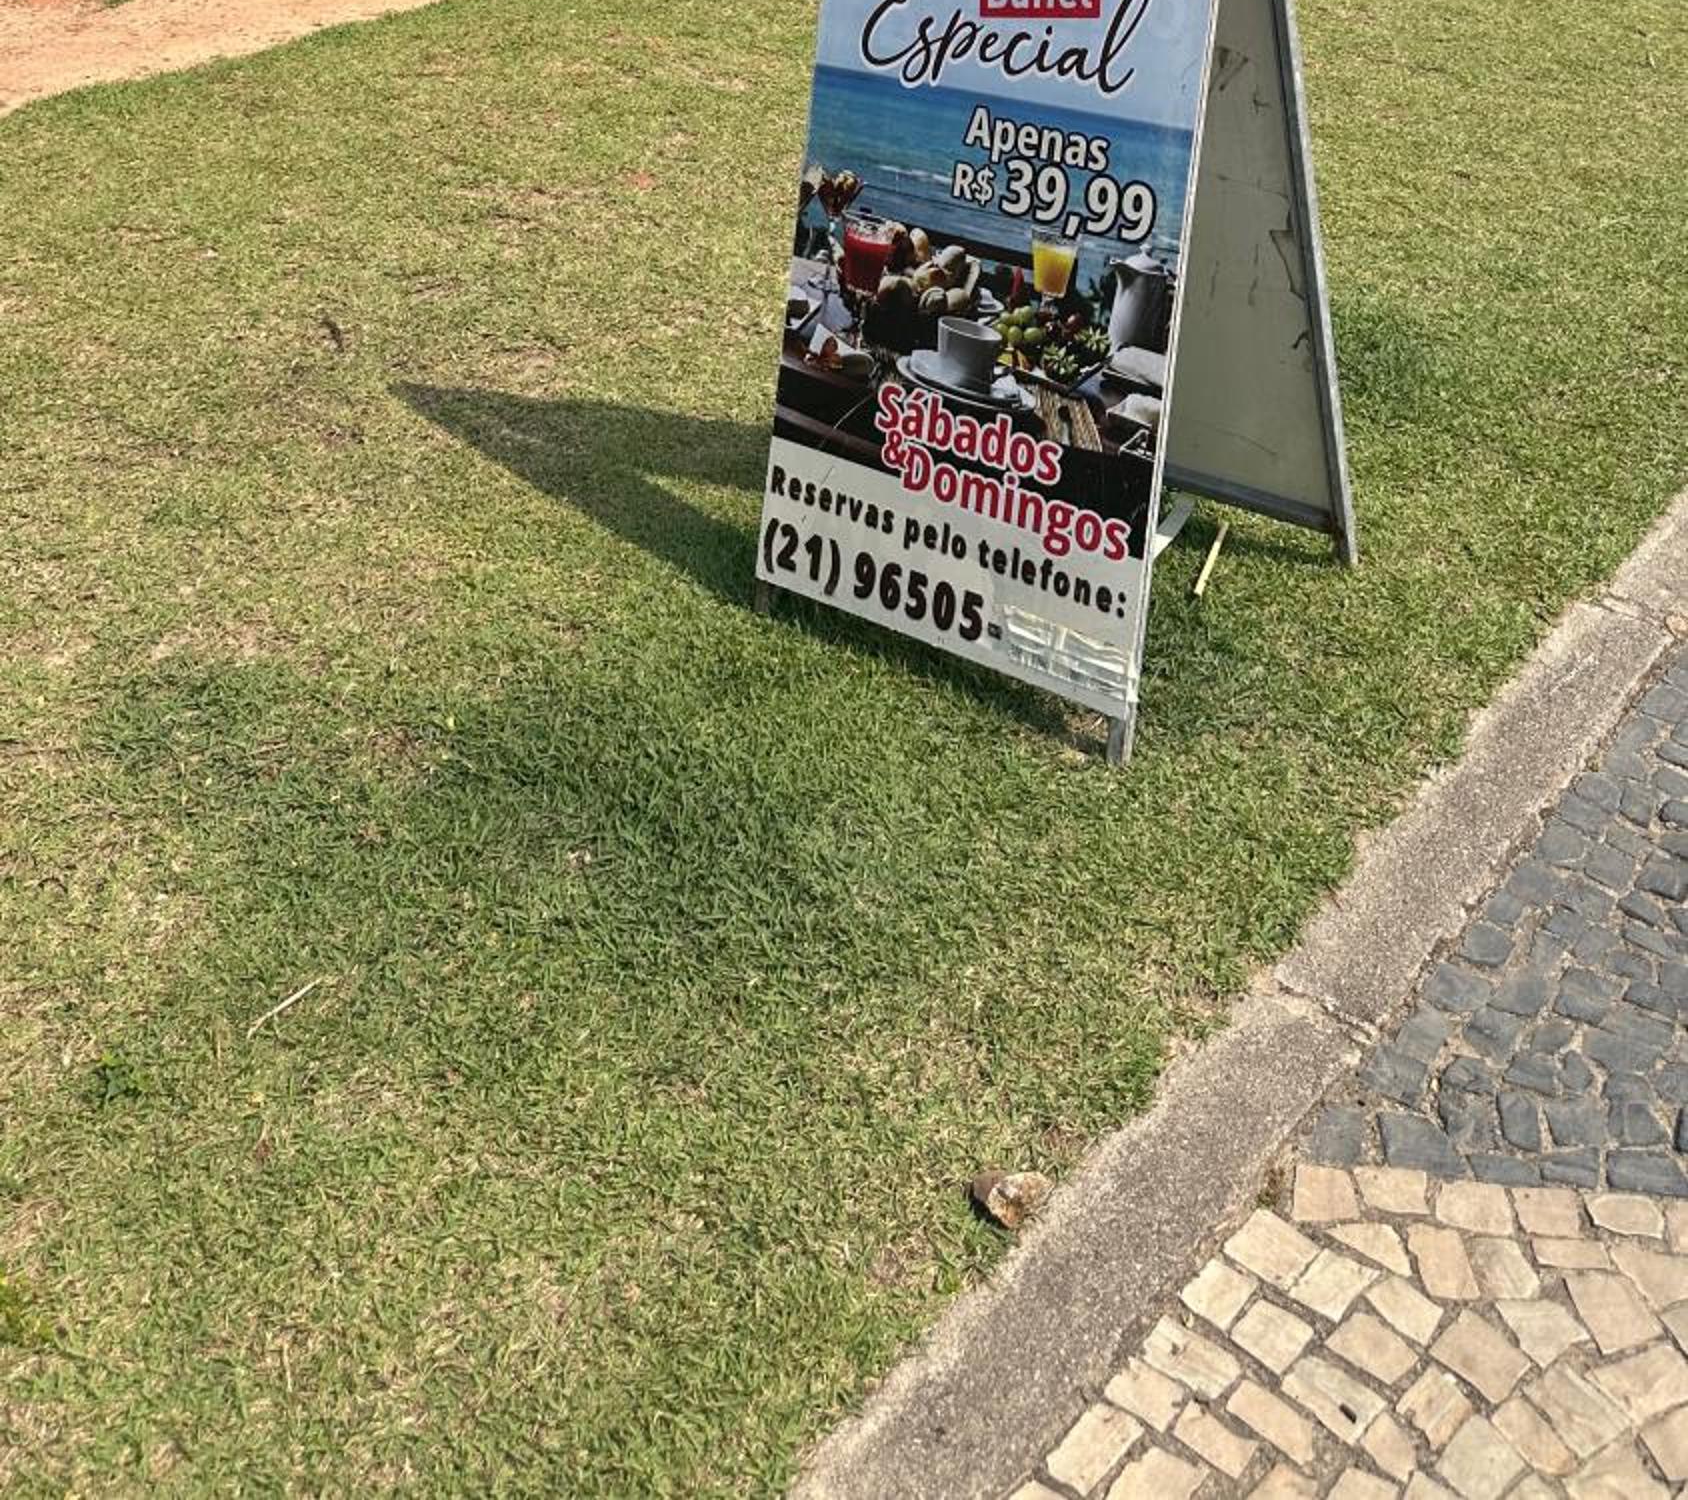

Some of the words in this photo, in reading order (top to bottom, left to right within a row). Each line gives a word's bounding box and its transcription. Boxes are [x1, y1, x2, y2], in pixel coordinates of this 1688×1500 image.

[964, 105, 1109, 172] Apenas
[952, 162, 997, 206] R$
[1000, 154, 1156, 242] 39,99
[875, 383, 1062, 485] Sábados
[770, 465, 894, 535] Reservas
[903, 517, 967, 560] pelo
[977, 539, 1127, 618] telefone:
